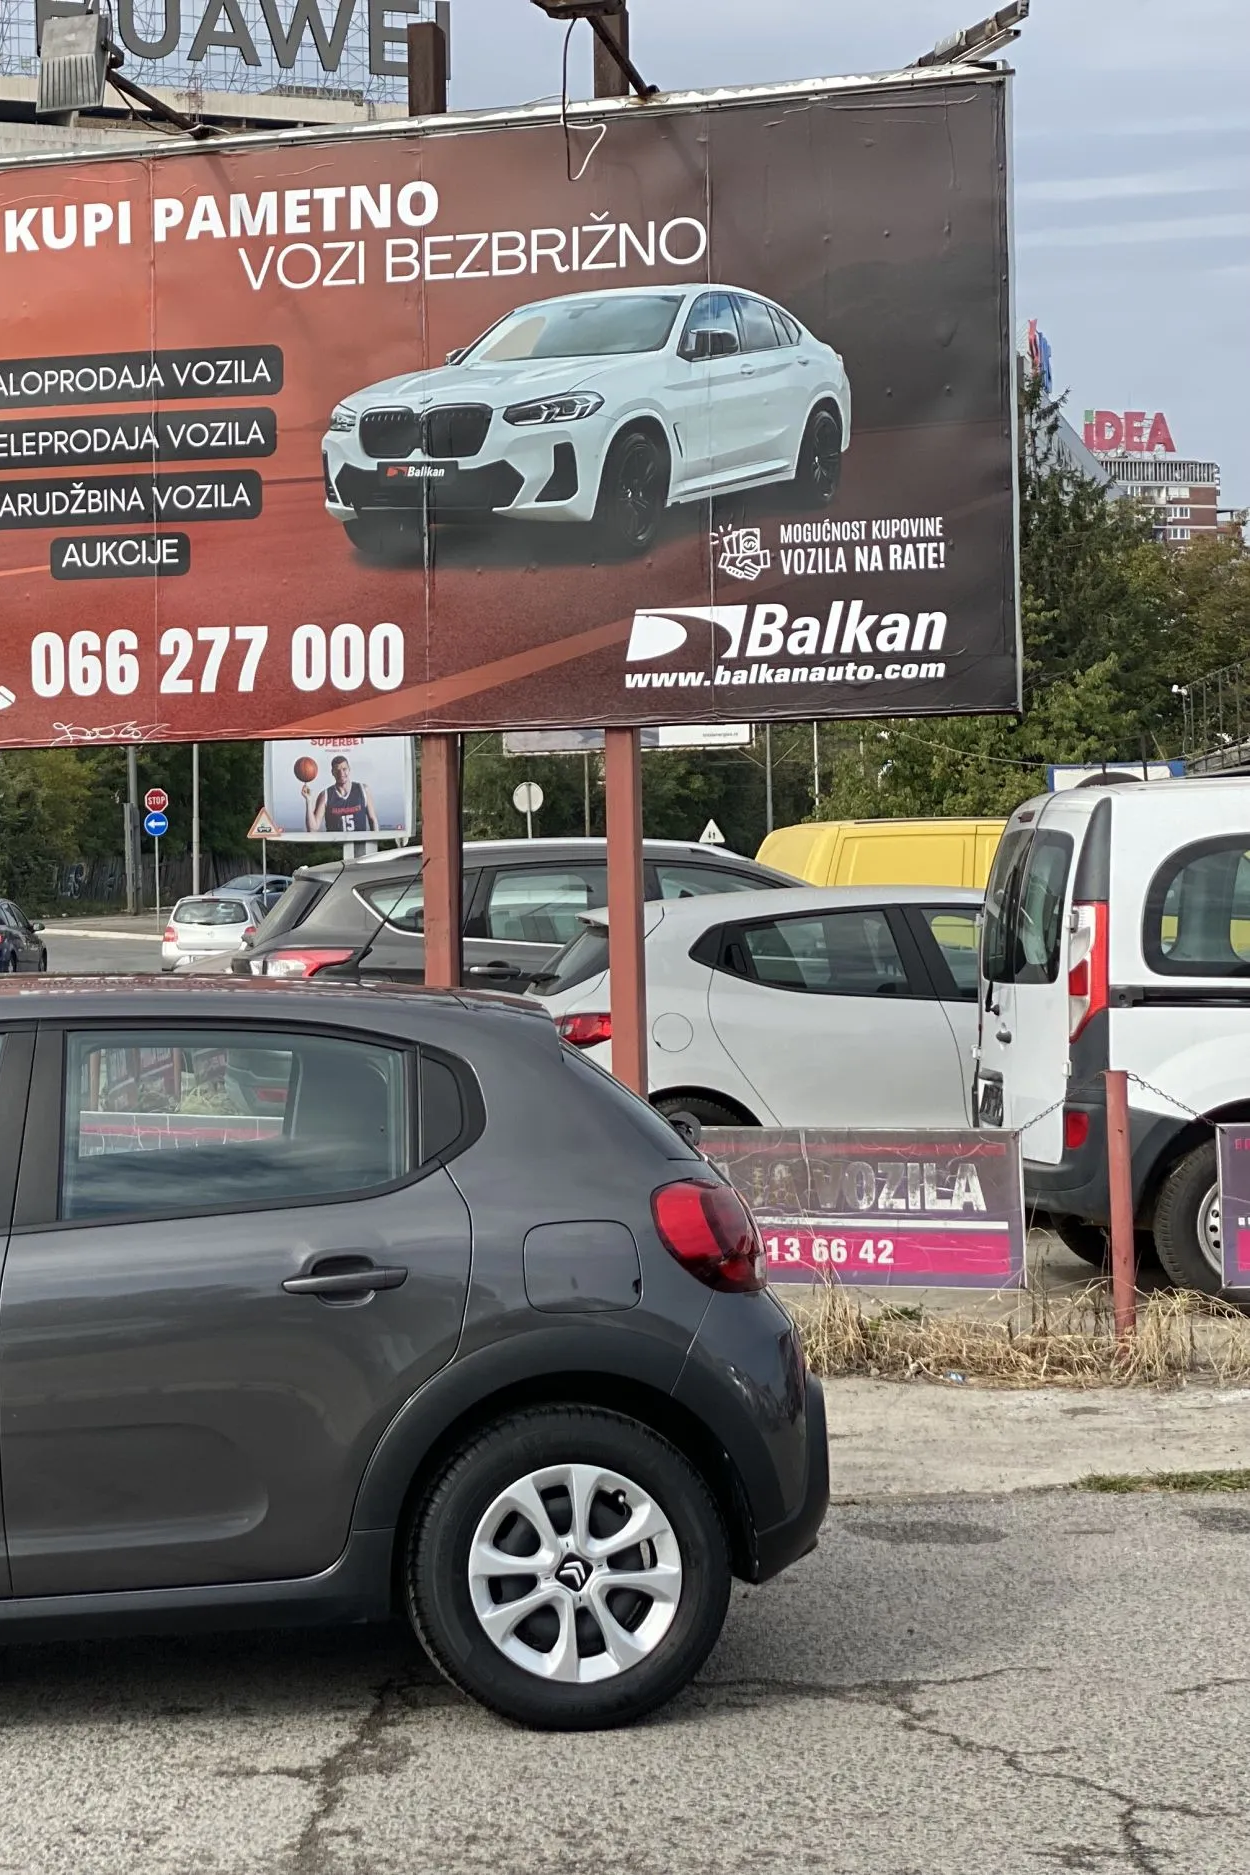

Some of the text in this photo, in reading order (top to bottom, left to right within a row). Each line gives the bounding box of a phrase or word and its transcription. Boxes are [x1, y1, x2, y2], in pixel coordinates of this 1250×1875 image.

[36, 0, 451, 81] UAWEI
[4, 180, 439, 253] KUPI PAMETNO
[238, 210, 708, 291] VOZI BEZBRIŽNO
[172, 358, 272, 387] VOZILA
[166, 420, 266, 448] VOZILA
[152, 482, 251, 510] VOZILA
[779, 516, 944, 544] MOGUĆNOST KUPOVINE
[61, 538, 180, 568] AUKCIJE
[780, 542, 946, 575] VOZILA NA RATE!
[745, 599, 948, 658] Balkan
[30, 622, 406, 698] 066 277 000
[624, 661, 946, 689] www.balkanauto.com
[147, 796, 166, 805] STOP
[341, 814, 355, 832] 15
[812, 1161, 988, 1212] VOZILA
[812, 1237, 848, 1263] 66
[858, 1239, 895, 1264] 42
